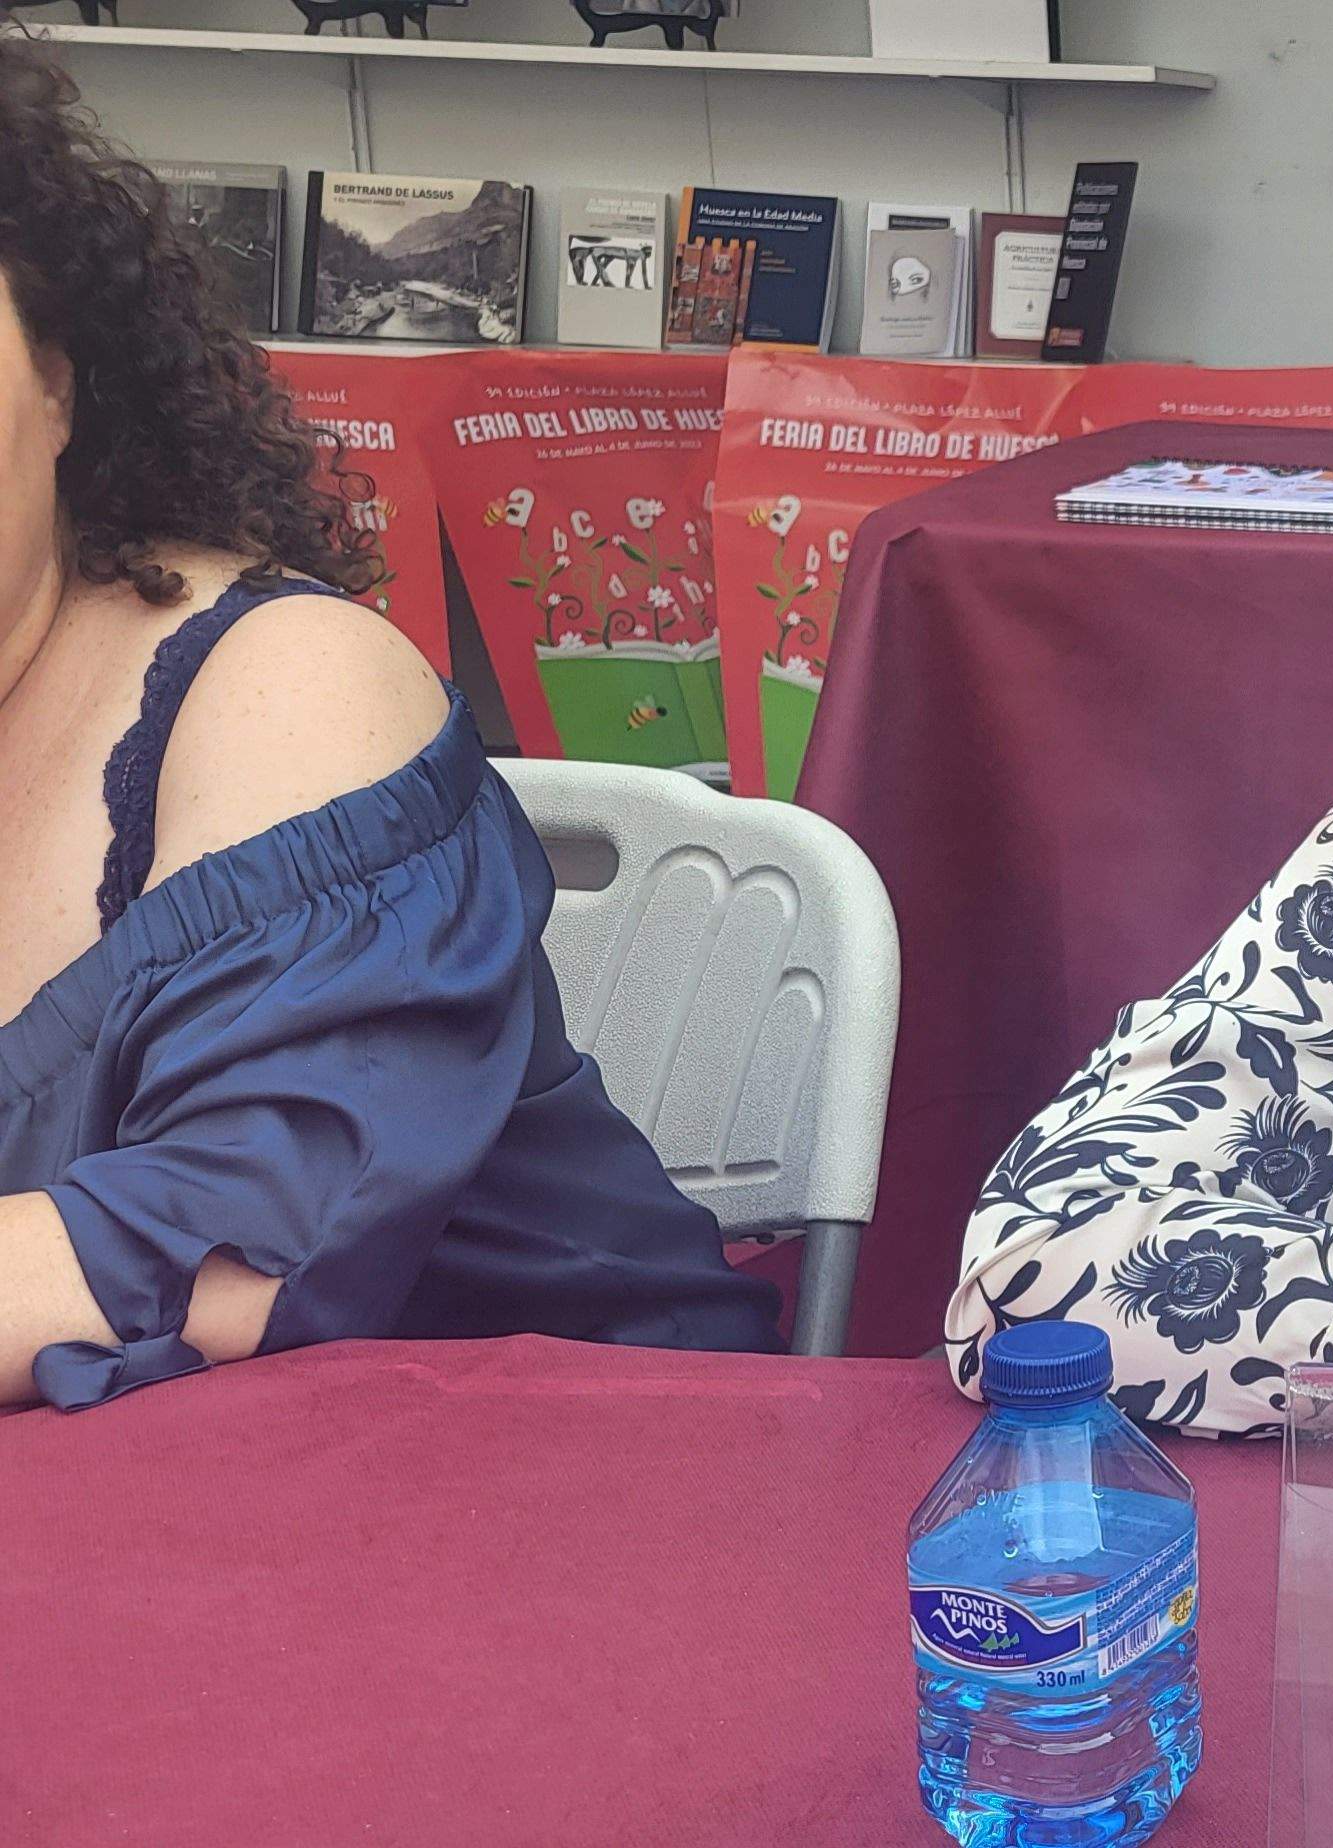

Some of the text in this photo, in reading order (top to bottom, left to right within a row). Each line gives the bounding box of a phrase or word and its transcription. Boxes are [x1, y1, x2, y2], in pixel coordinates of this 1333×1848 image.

[333, 184, 454, 200] BERTRAND DE LASSUS
[700, 204, 822, 223] Huesca en la Edad Media
[1003, 244, 1057, 255] AGRICULTUR
[894, 404, 935, 416] PLAZA
[941, 404, 981, 418] LÓPEZ
[1181, 403, 1234, 416] EDICIÓN
[1248, 406, 1291, 417] PLAZA
[454, 411, 522, 447] FERIA
[523, 411, 568, 438] DEL
[568, 408, 638, 435] LIBRO
[640, 409, 673, 431] DE
[760, 418, 825, 451] FERIA
[829, 424, 868, 454] DEL
[873, 428, 940, 459] LIBRO
[944, 432, 976, 460] DE
[941, 1592, 1007, 1619] MONTE
[950, 1608, 1008, 1634] PINOS
[1036, 1670, 1085, 1688] 330 ml
